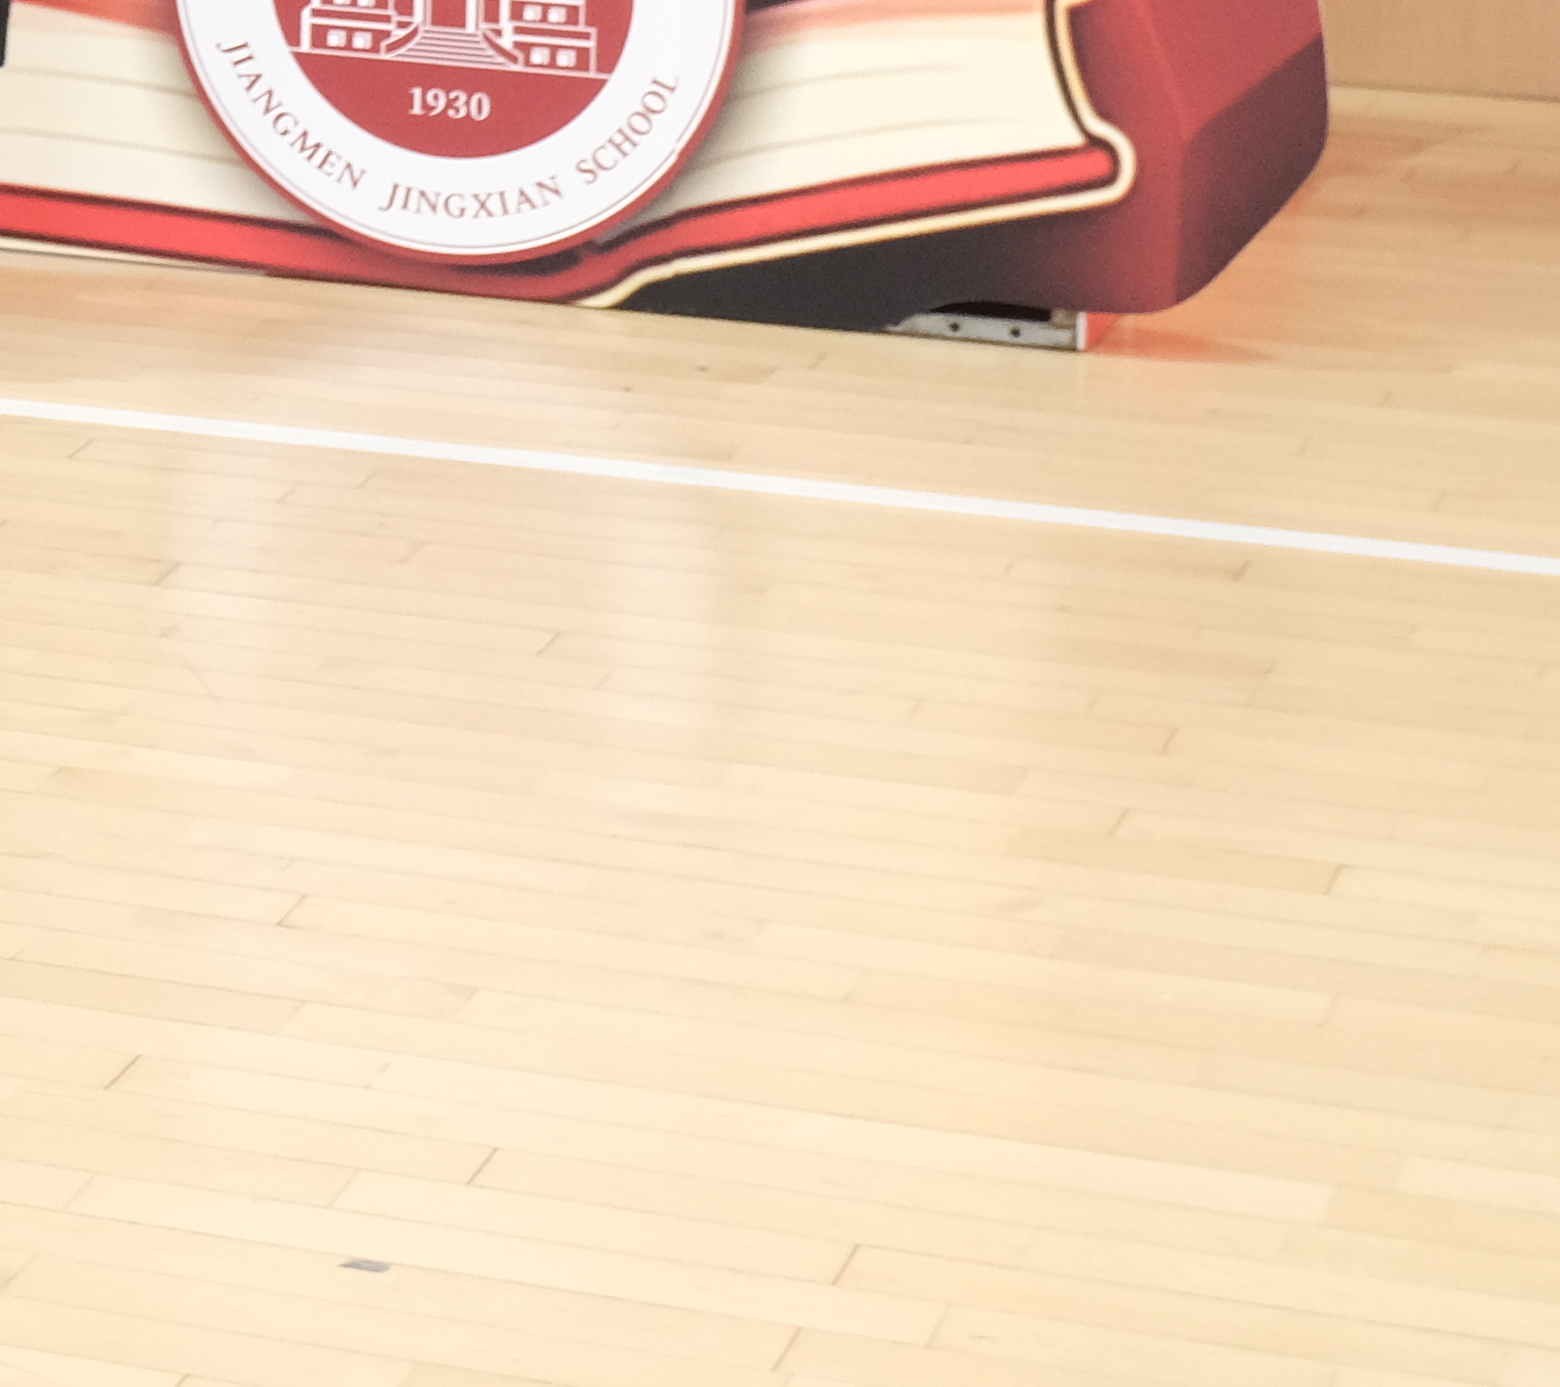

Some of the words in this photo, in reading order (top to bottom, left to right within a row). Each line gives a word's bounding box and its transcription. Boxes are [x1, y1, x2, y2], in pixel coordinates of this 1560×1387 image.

[215, 40, 367, 191] JIANGMEN
[377, 174, 565, 220] JINGXIAN
[574, 74, 680, 186] SCHOOL
[407, 86, 492, 121] 1930
